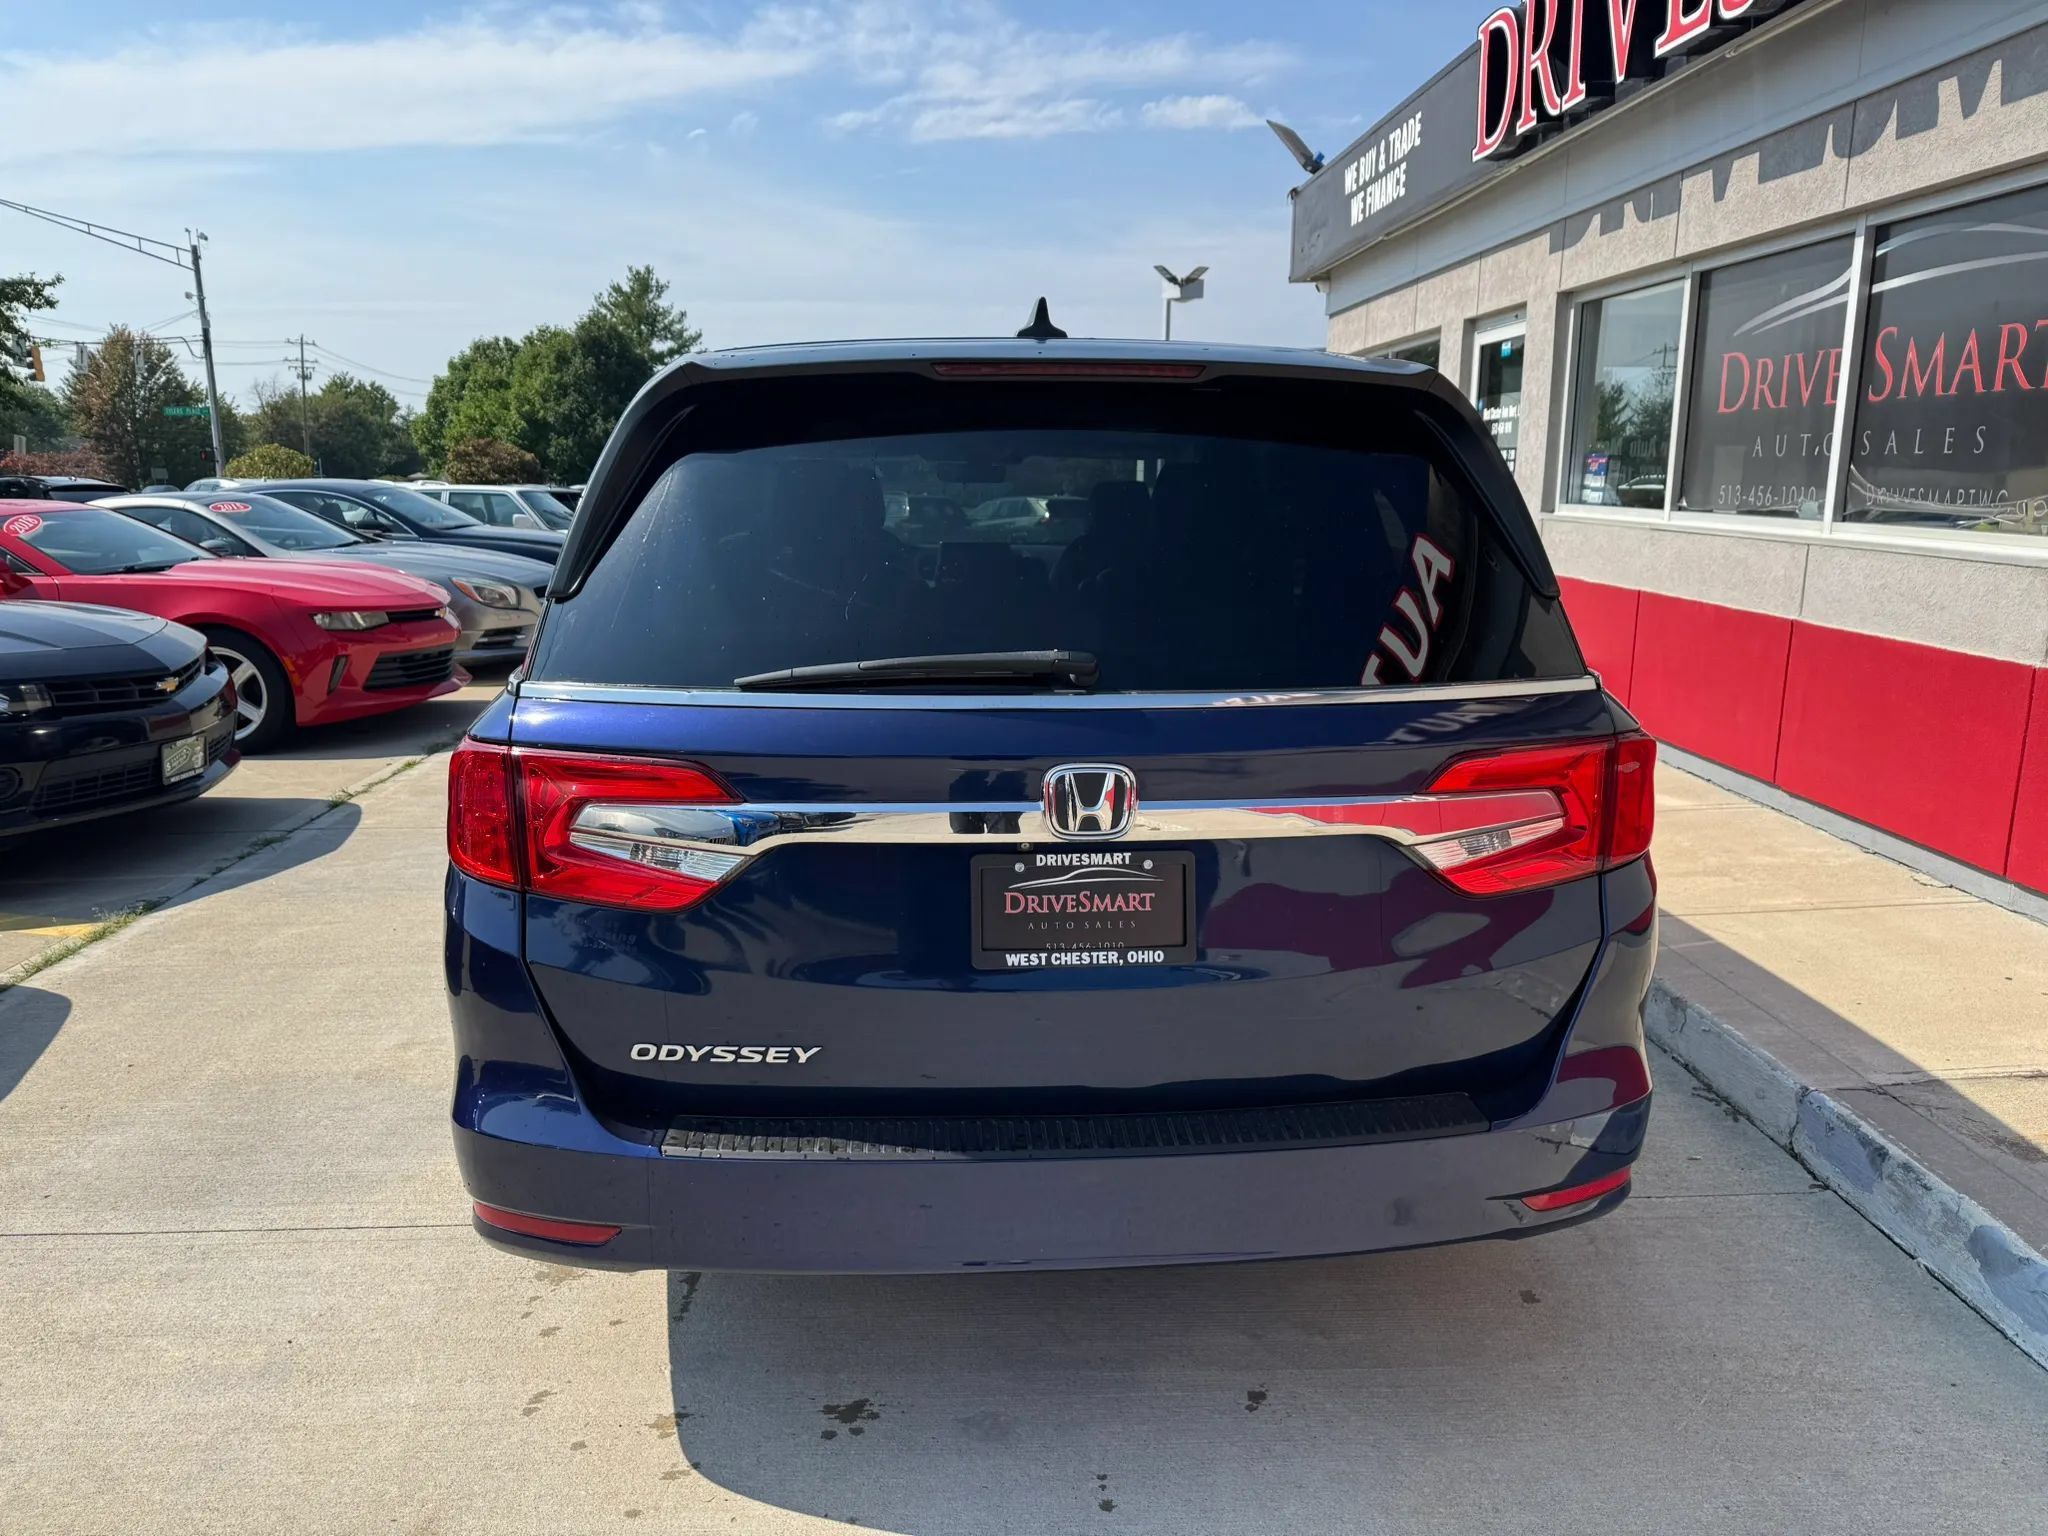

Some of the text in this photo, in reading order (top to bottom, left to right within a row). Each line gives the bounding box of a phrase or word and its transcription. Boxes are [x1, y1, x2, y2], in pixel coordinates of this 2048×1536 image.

[1344, 111, 1422, 195] WE BUY & TRADE
[1350, 161, 1406, 227] WE FINANCE
[1860, 426, 1986, 455] SALES
[1718, 485, 1816, 506] 513-456-1010
[1036, 852, 1132, 867] DRIVESMART
[1004, 891, 1155, 914] DRIVESMART
[1028, 919, 1136, 930] AUTO SALES
[1005, 950, 1165, 967] WEST CHESTER, OHIO
[630, 1043, 822, 1064] ODYSSEY
